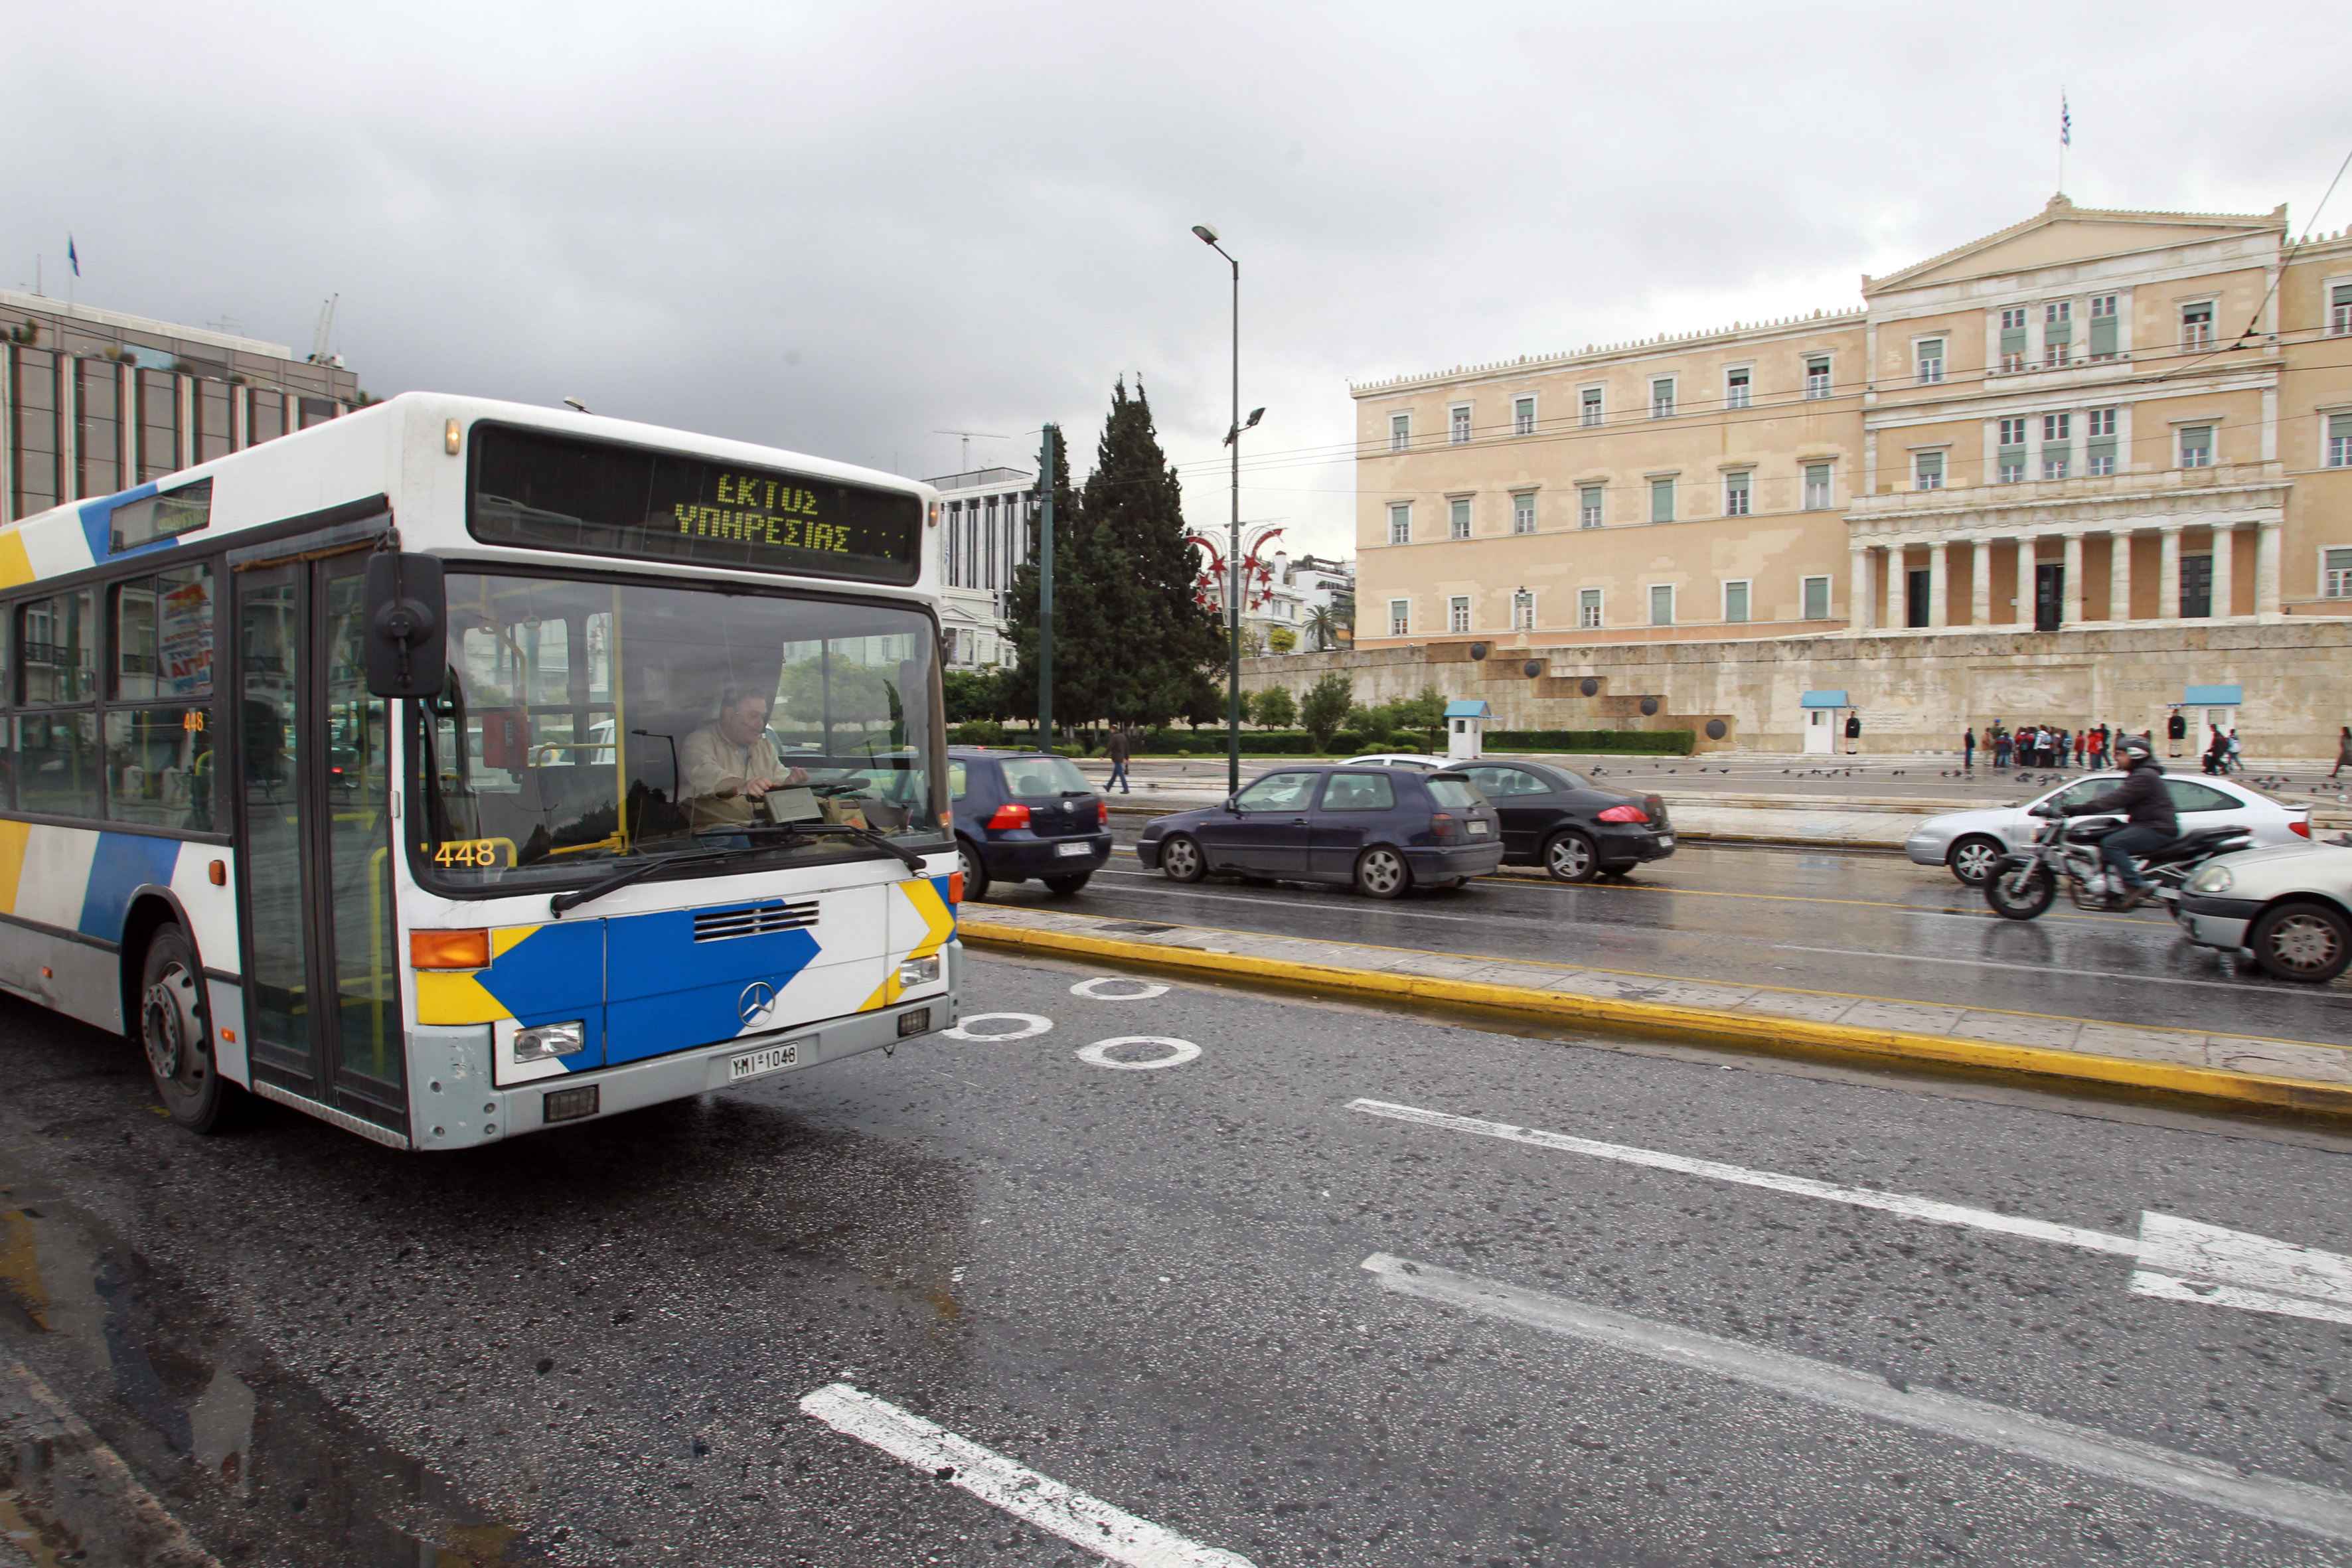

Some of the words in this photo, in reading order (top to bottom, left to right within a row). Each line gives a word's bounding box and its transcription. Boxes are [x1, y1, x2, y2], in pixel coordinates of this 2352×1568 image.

[674, 503, 850, 553] ΥΠΗΡΕΣΙΑΣ
[183, 712, 204, 733] 448
[434, 840, 495, 868] 448
